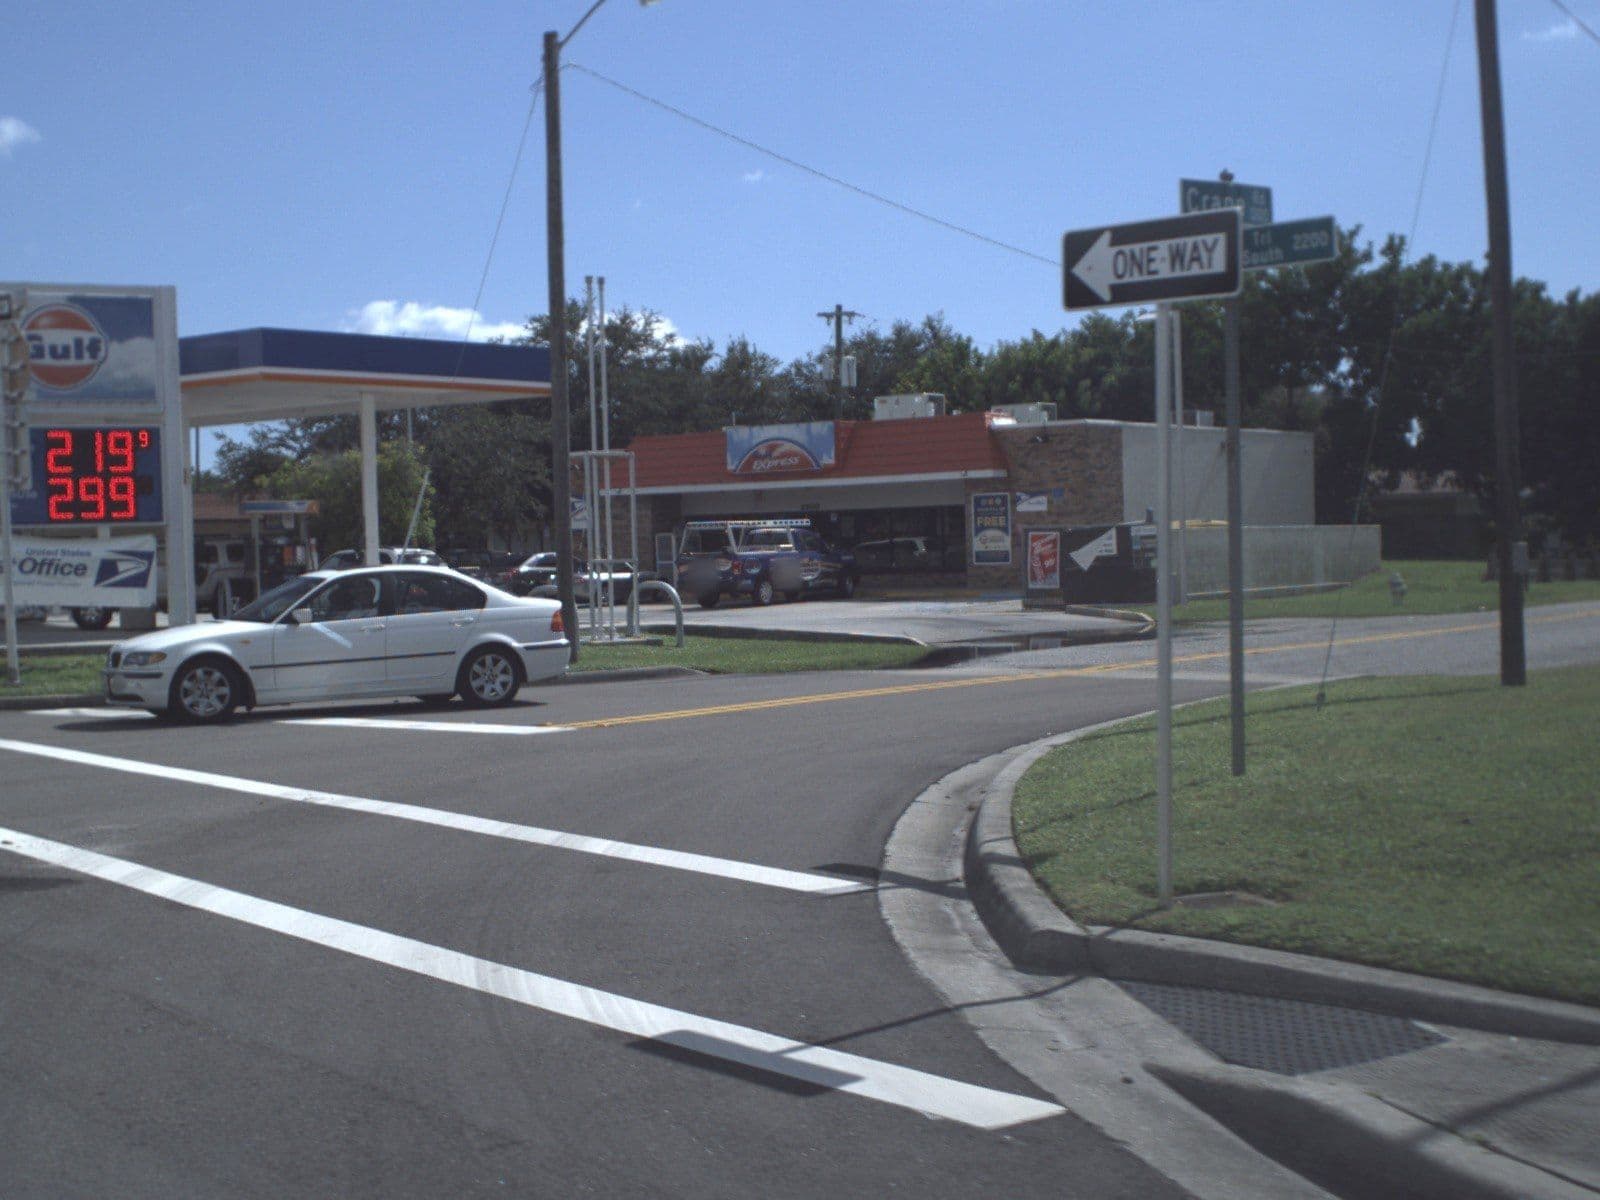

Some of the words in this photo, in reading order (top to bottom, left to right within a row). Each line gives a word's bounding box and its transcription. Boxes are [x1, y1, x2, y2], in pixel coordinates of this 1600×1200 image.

[1113, 247, 1158, 279] ONE
[1168, 236, 1220, 273] WAY
[27, 333, 101, 360] Gulf
[47, 430, 134, 473] 219
[138, 431, 149, 448] 9
[48, 476, 136, 520] 299
[18, 556, 88, 577] Office
